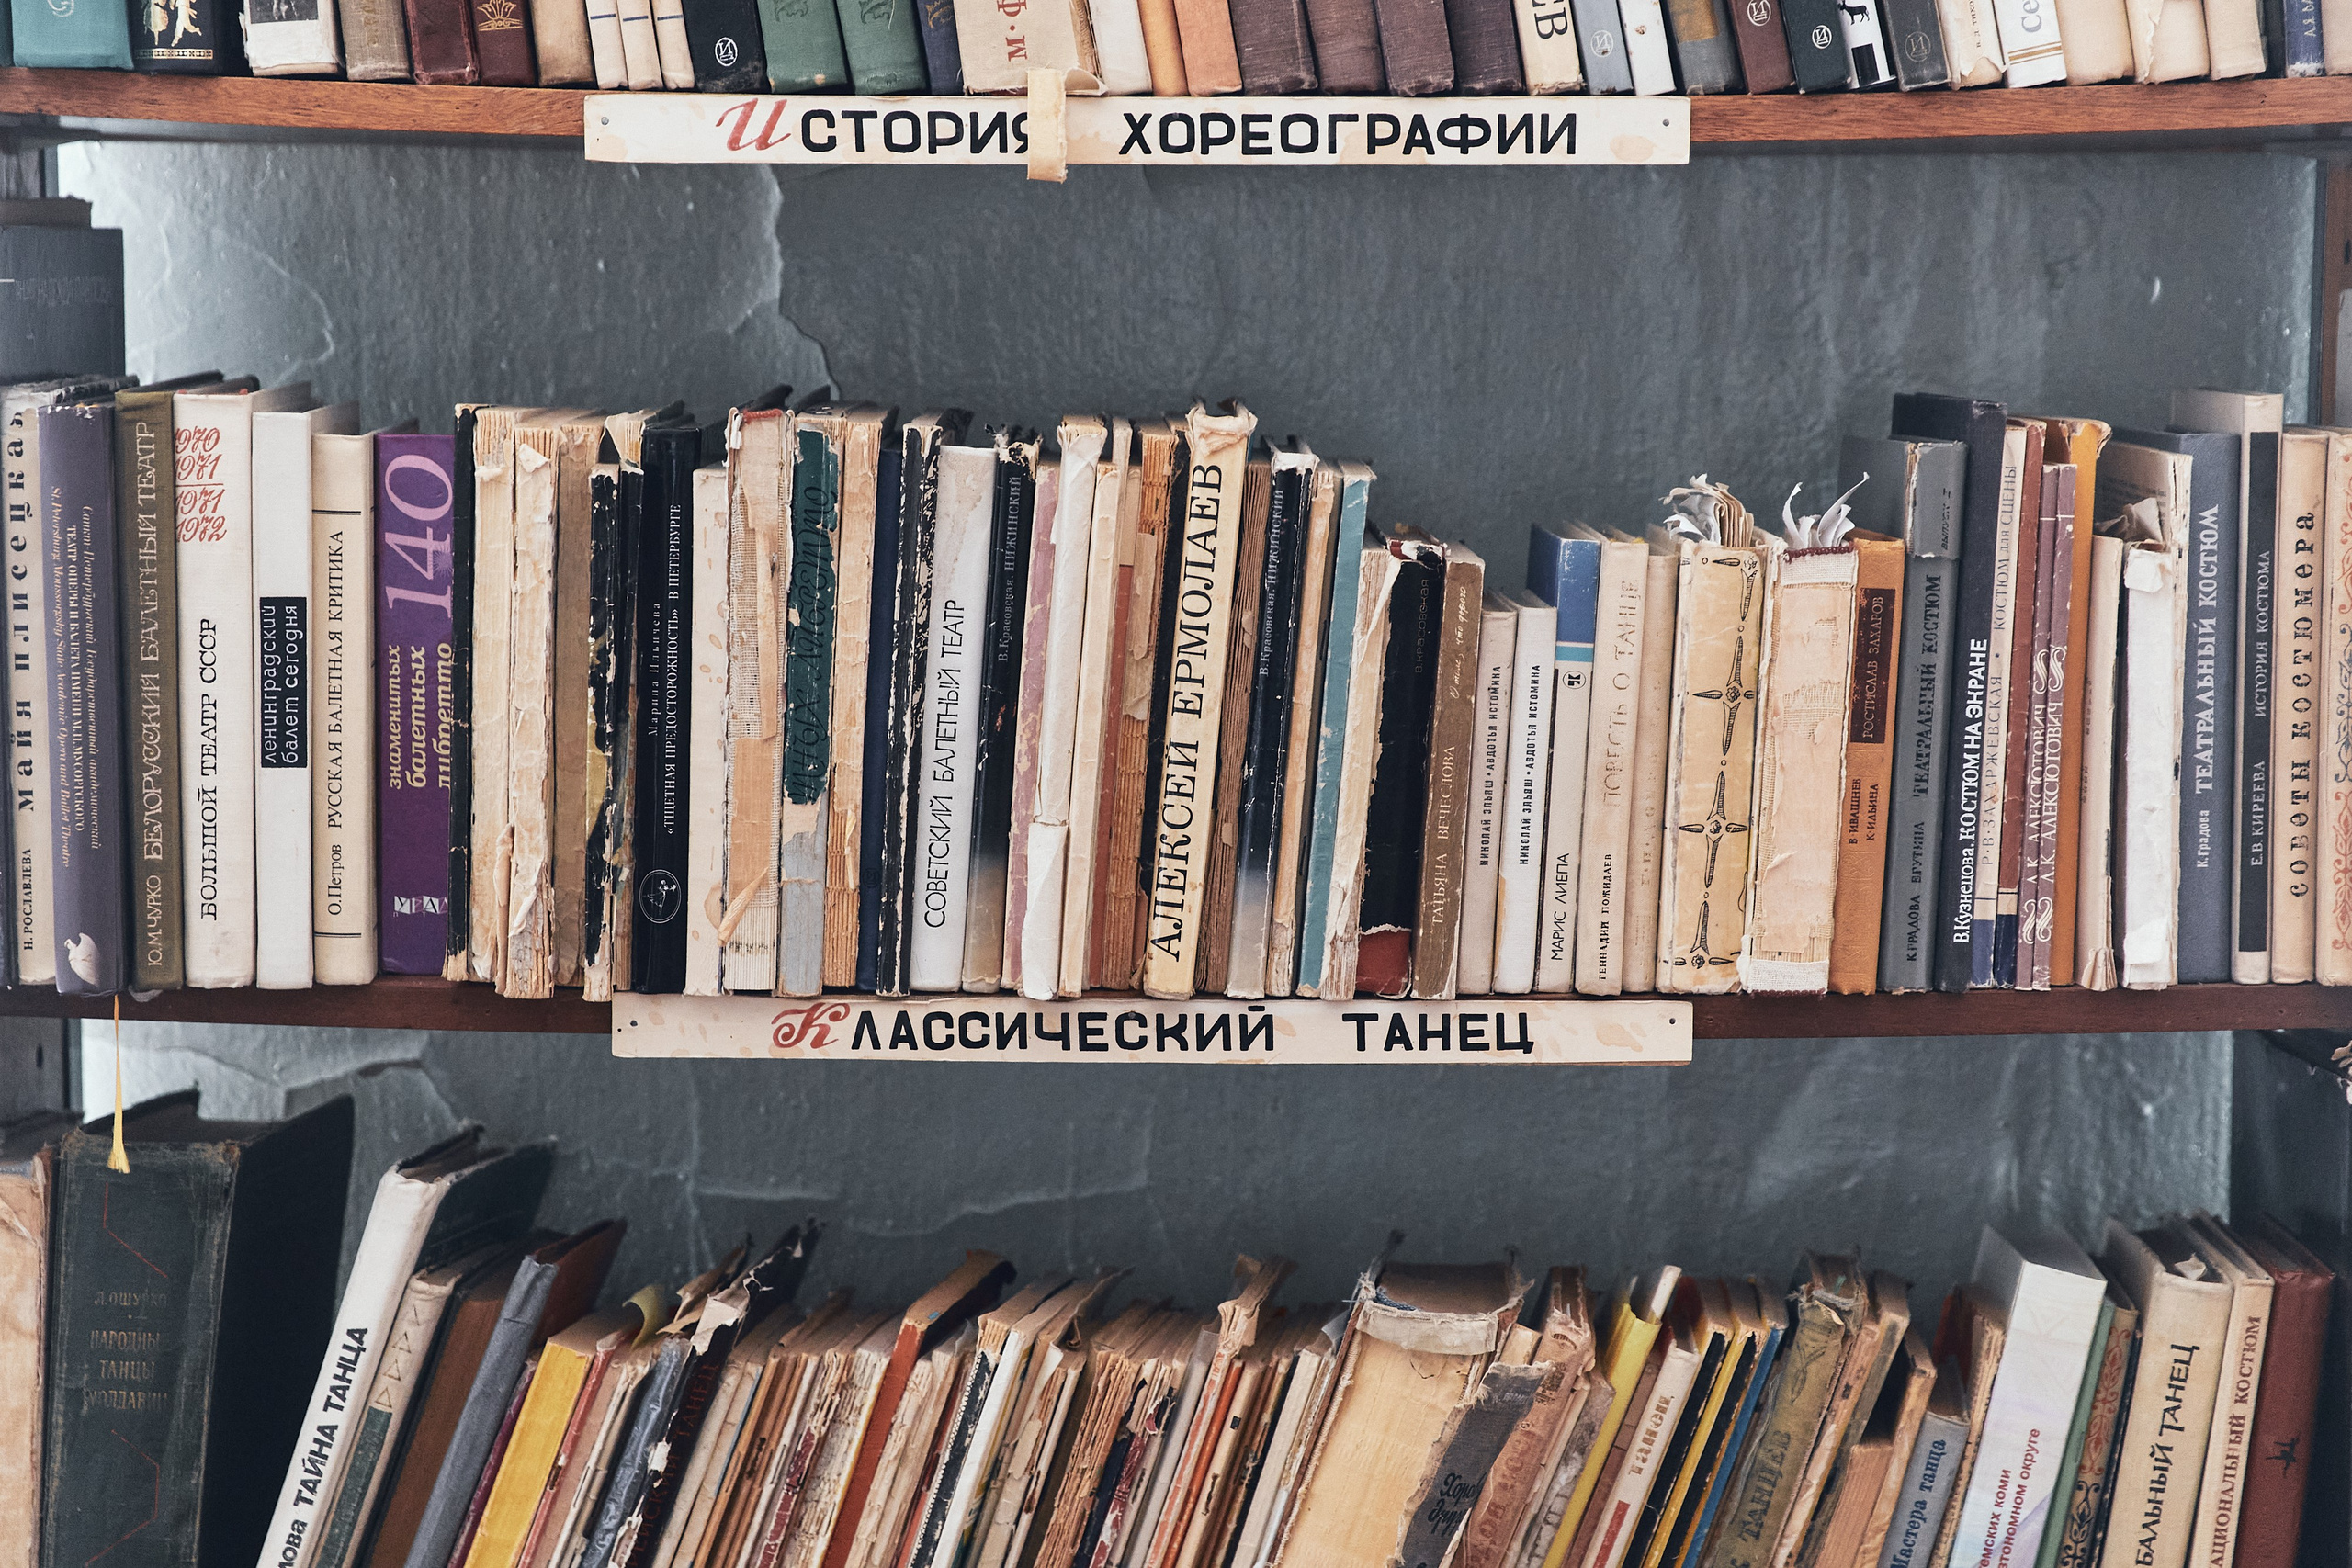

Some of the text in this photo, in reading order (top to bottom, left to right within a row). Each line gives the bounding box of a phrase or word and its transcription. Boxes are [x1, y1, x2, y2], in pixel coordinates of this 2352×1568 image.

[1118, 111, 1577, 156] ХОРЕОГРАФИИ
[135, 422, 157, 507] ТЕАТР
[2000, 465, 2018, 526] СЦЕНЫ
[66, 525, 77, 562] ТЕАТР
[383, 452, 453, 619] 140
[1004, 475, 1023, 572] НИЖИНСКИЙ
[1999, 529, 2011, 554] для
[2198, 504, 2220, 608] КОСТЮМ
[68, 564, 79, 608] ОПЕРЫ
[69, 610, 79, 620] И
[136, 513, 160, 662] БАЛЕТНЫЙ
[327, 530, 344, 622] КРИТИКА
[1921, 574, 1941, 655] КОСТЮМ
[1993, 558, 2010, 631] КОСТЮМ
[2256, 551, 2270, 634] КОСТЮМА
[51, 486, 73, 868] St. Petersburg Moussorgsky State Academic Opera and Ballet Theatre
[70, 622, 81, 668] БАЛЕТА
[81, 505, 102, 850] Санкт-Петербургский Государственный академический
[261, 604, 282, 764] ленинградский
[282, 604, 303, 763] балет сегодня
[327, 630, 343, 734] БАЛЕТНАЯ
[648, 602, 662, 736] Марина Ильичева
[663, 503, 682, 835] «ТЩЕТНАЯ ПРЕДОСТОРОЖНОСТЬ» В ПЕТЕРБУРГЕ
[1611, 672, 1631, 691] О
[1862, 596, 1884, 739] РОСТИСЛАВ ЗАХАРОВ
[1964, 638, 1988, 719] ЭКРАНЕ
[2254, 641, 2268, 717] ИСТОРИЯ
[71, 671, 82, 716] ИМЕНИ
[387, 644, 401, 790] знаменитых
[405, 645, 426, 788] балетных
[432, 642, 449, 790] либретто
[1151, 462, 1223, 964] АЛЕКСЕЙ ЕРМОЛАЕВ
[1487, 666, 1501, 720] ИСТОМИНА
[1528, 664, 1541, 719] ИСТОМИНА
[1912, 663, 1937, 798] ТЕАТРАЛЬНЫЙ
[1963, 721, 1983, 750] НА
[2192, 616, 2217, 795] ТЕАТРАЛЬНЫЙ
[140, 672, 164, 861] БЕЛОРУССКИЙ
[197, 618, 218, 922] БОЛЬШОЙ ТЕАТР СССР
[327, 741, 343, 829] РУССКАЯ
[922, 599, 966, 930] СОВЕТСКИЙ БАЛЕТНЫЙ ТЕАТР
[1485, 724, 1498, 771] АВДОТЬЯ
[1524, 723, 1538, 770] АВДОТЬЯ
[1602, 703, 1628, 807] ПОВЕСТЬ
[2042, 701, 2063, 841] АЛЕКСЮТОВИЧ
[1431, 745, 1456, 927] ТАТЬЯНА ВЕЧЕСЛОВА
[1519, 818, 1532, 865] НИКОЛАЙ
[1958, 752, 1981, 841] КОСТЮМ
[2251, 760, 2266, 836] КИРЕЕВА
[1479, 819, 1493, 866] НИКОЛАЙ
[21, 848, 34, 934] РОСЛАВЛЕВА
[1550, 852, 1571, 962] МАРИС ЛИЕПА
[1598, 853, 1614, 981] ГЕННАДИЙ ПОЖИДАЕВ
[771, 1001, 1535, 1055] КЛАССИЧЕСКИЙ ТАНЕЦ
[90, 1330, 161, 1350] НАРОДНЫ
[2232, 1316, 2262, 1407] КОСТЮМ
[293, 1424, 338, 1506] ТАЙНА
[322, 1327, 368, 1413] ТАНЦА
[2018, 1427, 2041, 1481] округе
[2135, 1343, 2201, 1567] БАЛЬНЫЙ ТАНЕЦ
[1890, 1438, 1947, 1568] Мастера танца
[1994, 1468, 2012, 1508] коми
